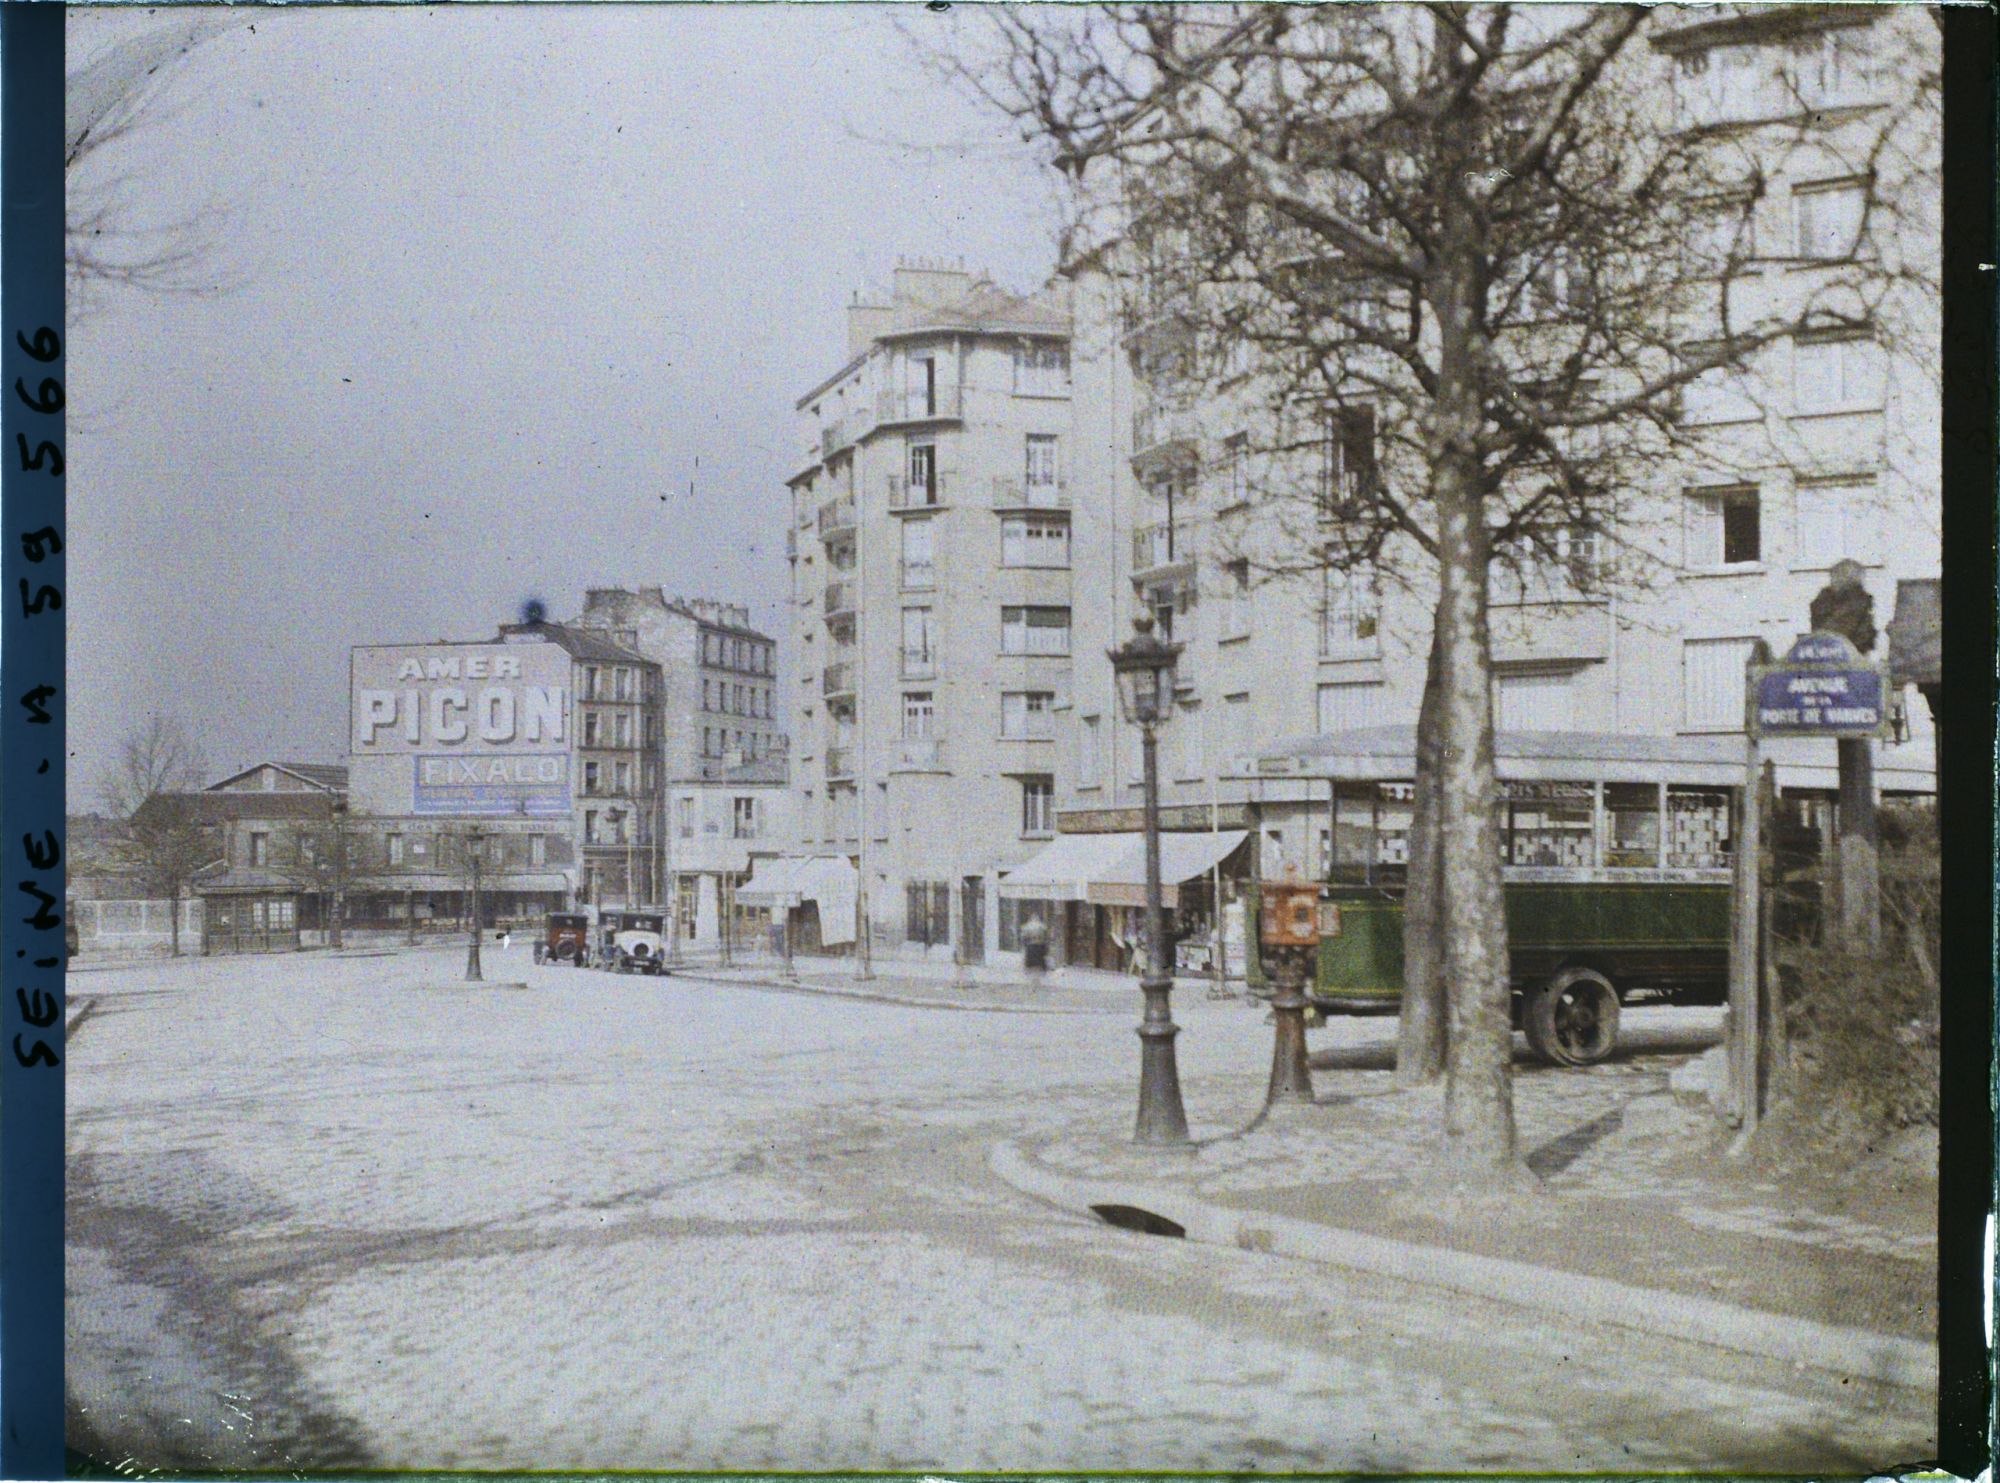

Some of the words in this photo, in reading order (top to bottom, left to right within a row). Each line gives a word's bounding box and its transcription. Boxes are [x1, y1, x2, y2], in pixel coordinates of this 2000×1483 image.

[400, 655, 522, 681] AMER
[360, 685, 565, 746] PICON
[423, 757, 561, 784] FIXALO
